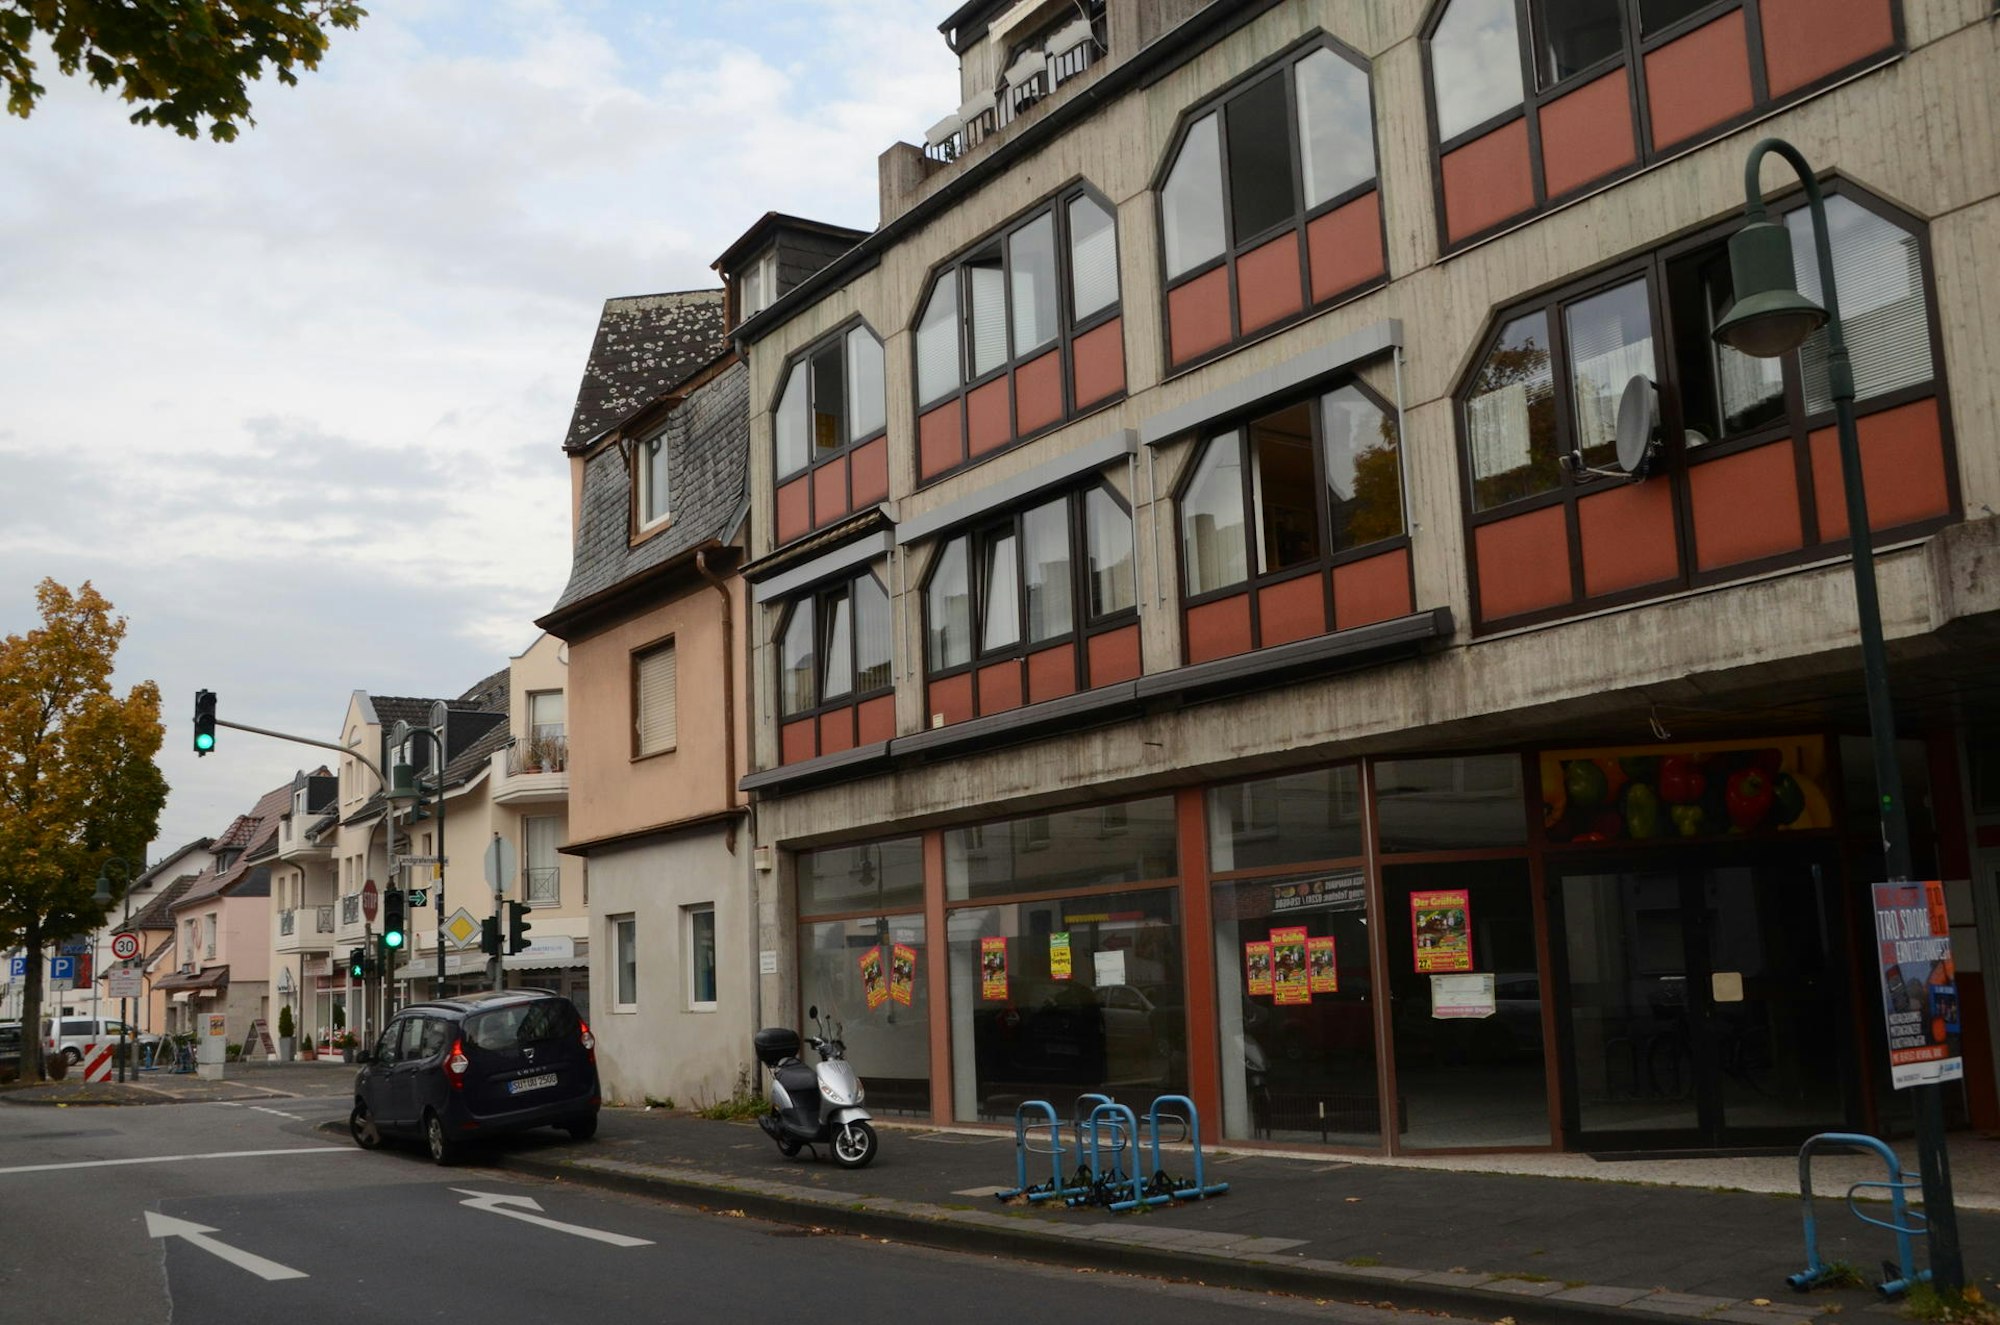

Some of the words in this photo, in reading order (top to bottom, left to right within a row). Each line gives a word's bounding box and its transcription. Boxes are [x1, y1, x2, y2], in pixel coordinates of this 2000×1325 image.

[363, 892, 378, 909] STOP
[1414, 898, 1429, 906] Der
[118, 940, 134, 953] 30
[13, 960, 24, 975] P
[55, 959, 69, 976] P
